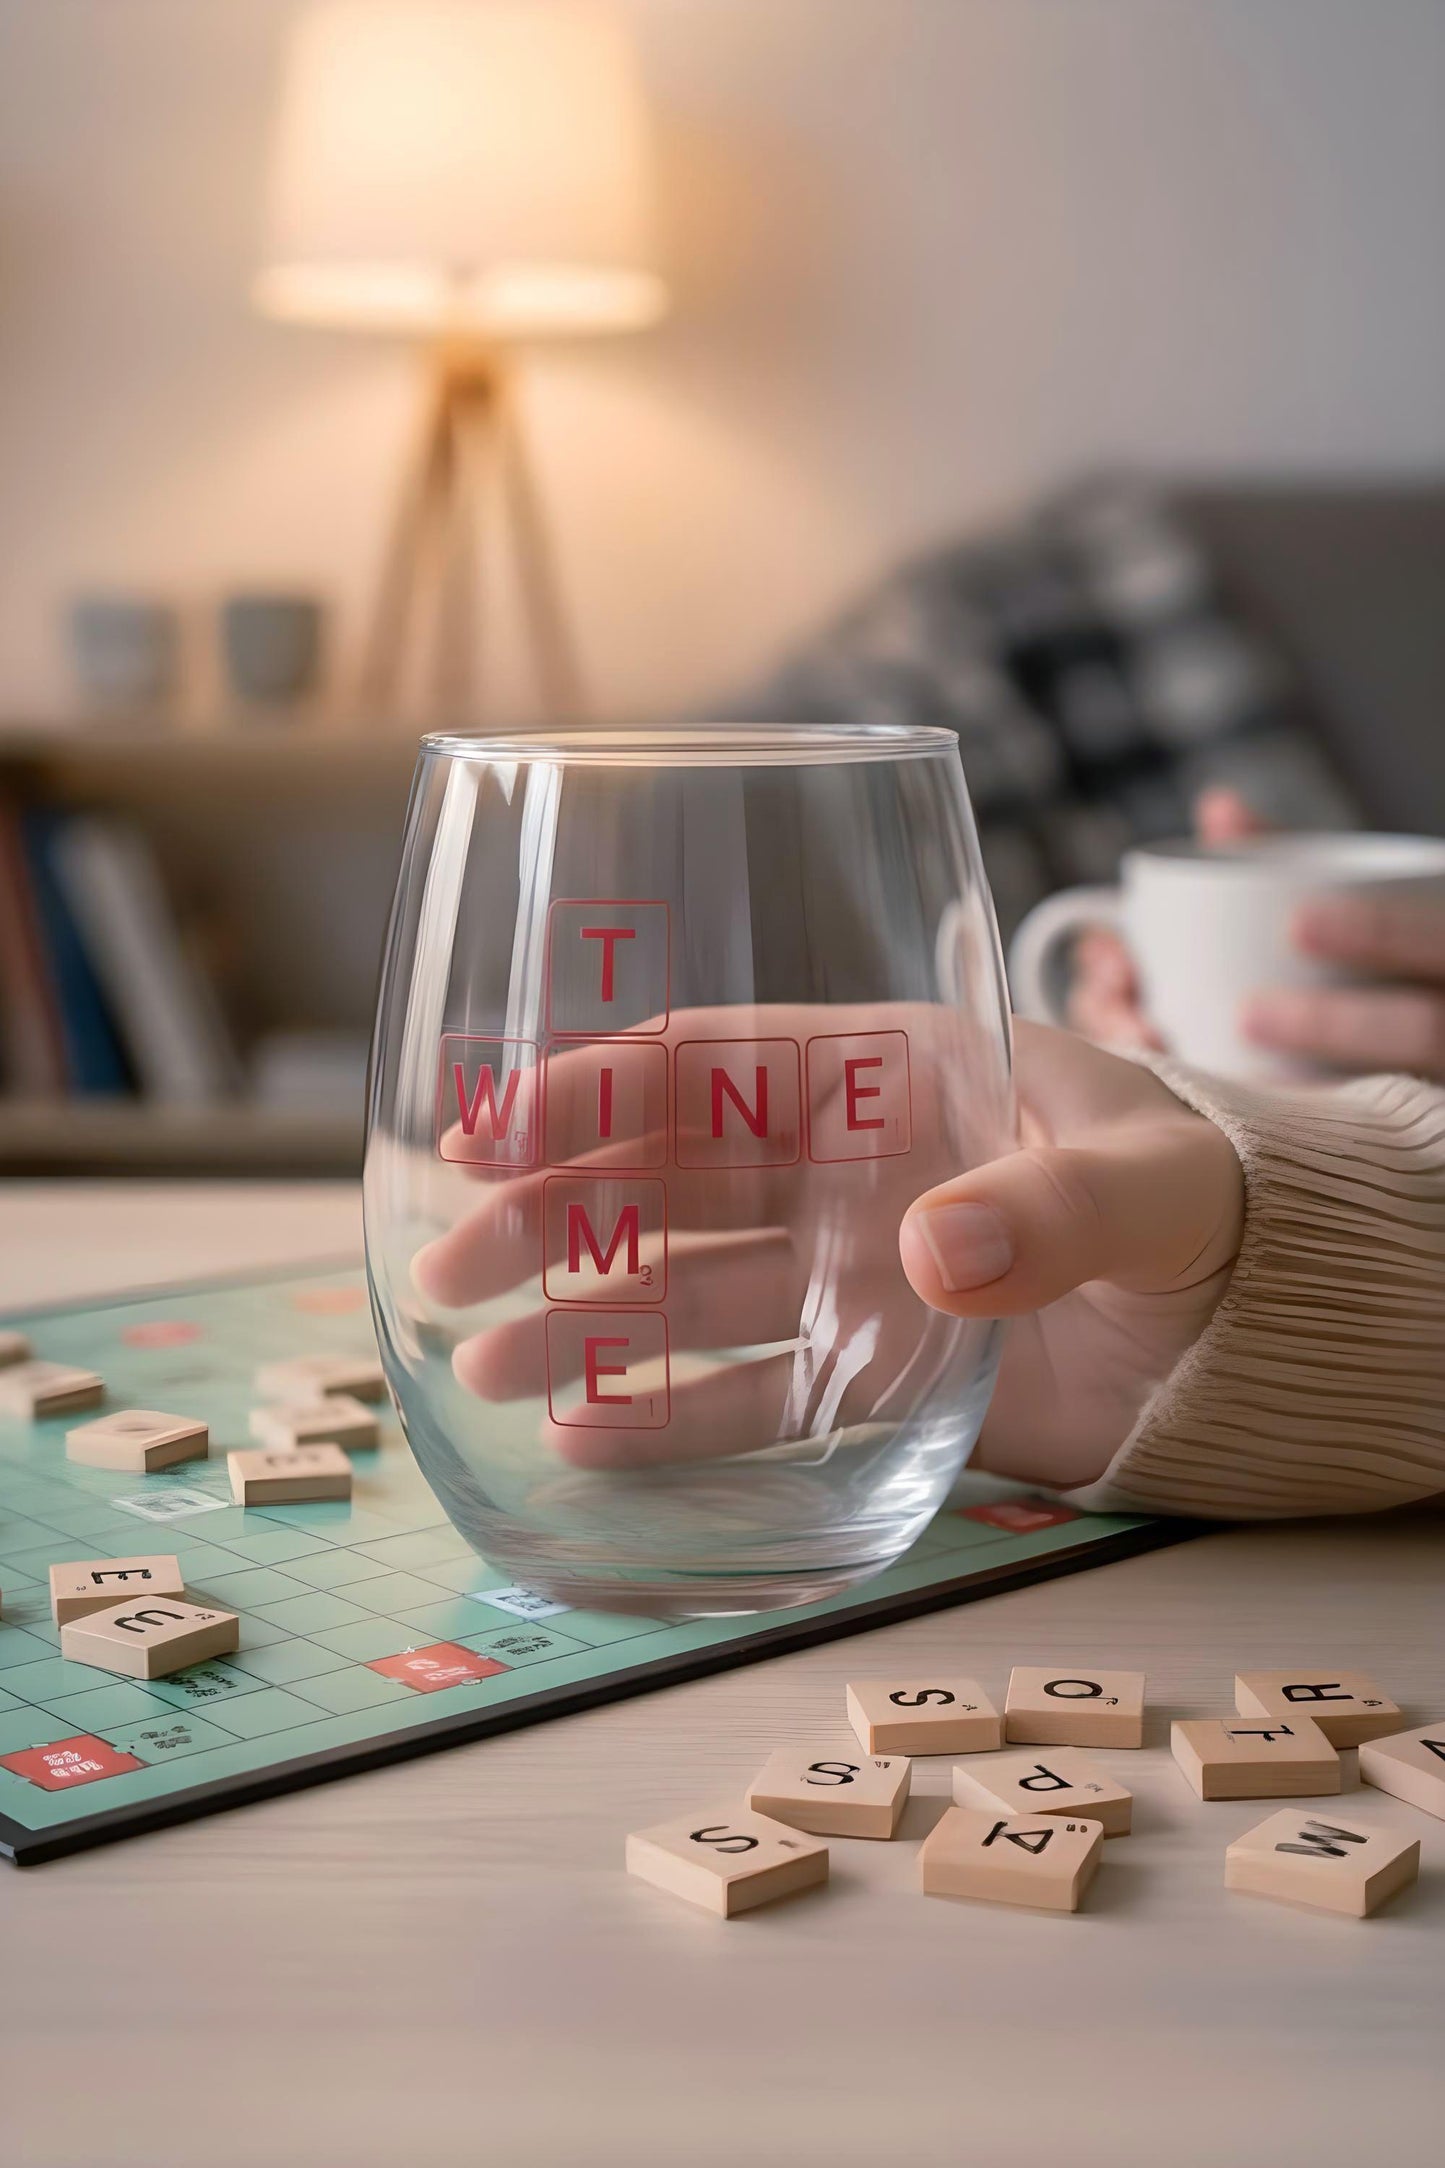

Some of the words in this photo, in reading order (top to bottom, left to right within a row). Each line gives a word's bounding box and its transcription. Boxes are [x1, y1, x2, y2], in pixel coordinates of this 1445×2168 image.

[453, 1056, 885, 1141] WINE
[888, 1688, 956, 1707] S
[1281, 1683, 1355, 1703] R
[689, 1825, 759, 1854] S
